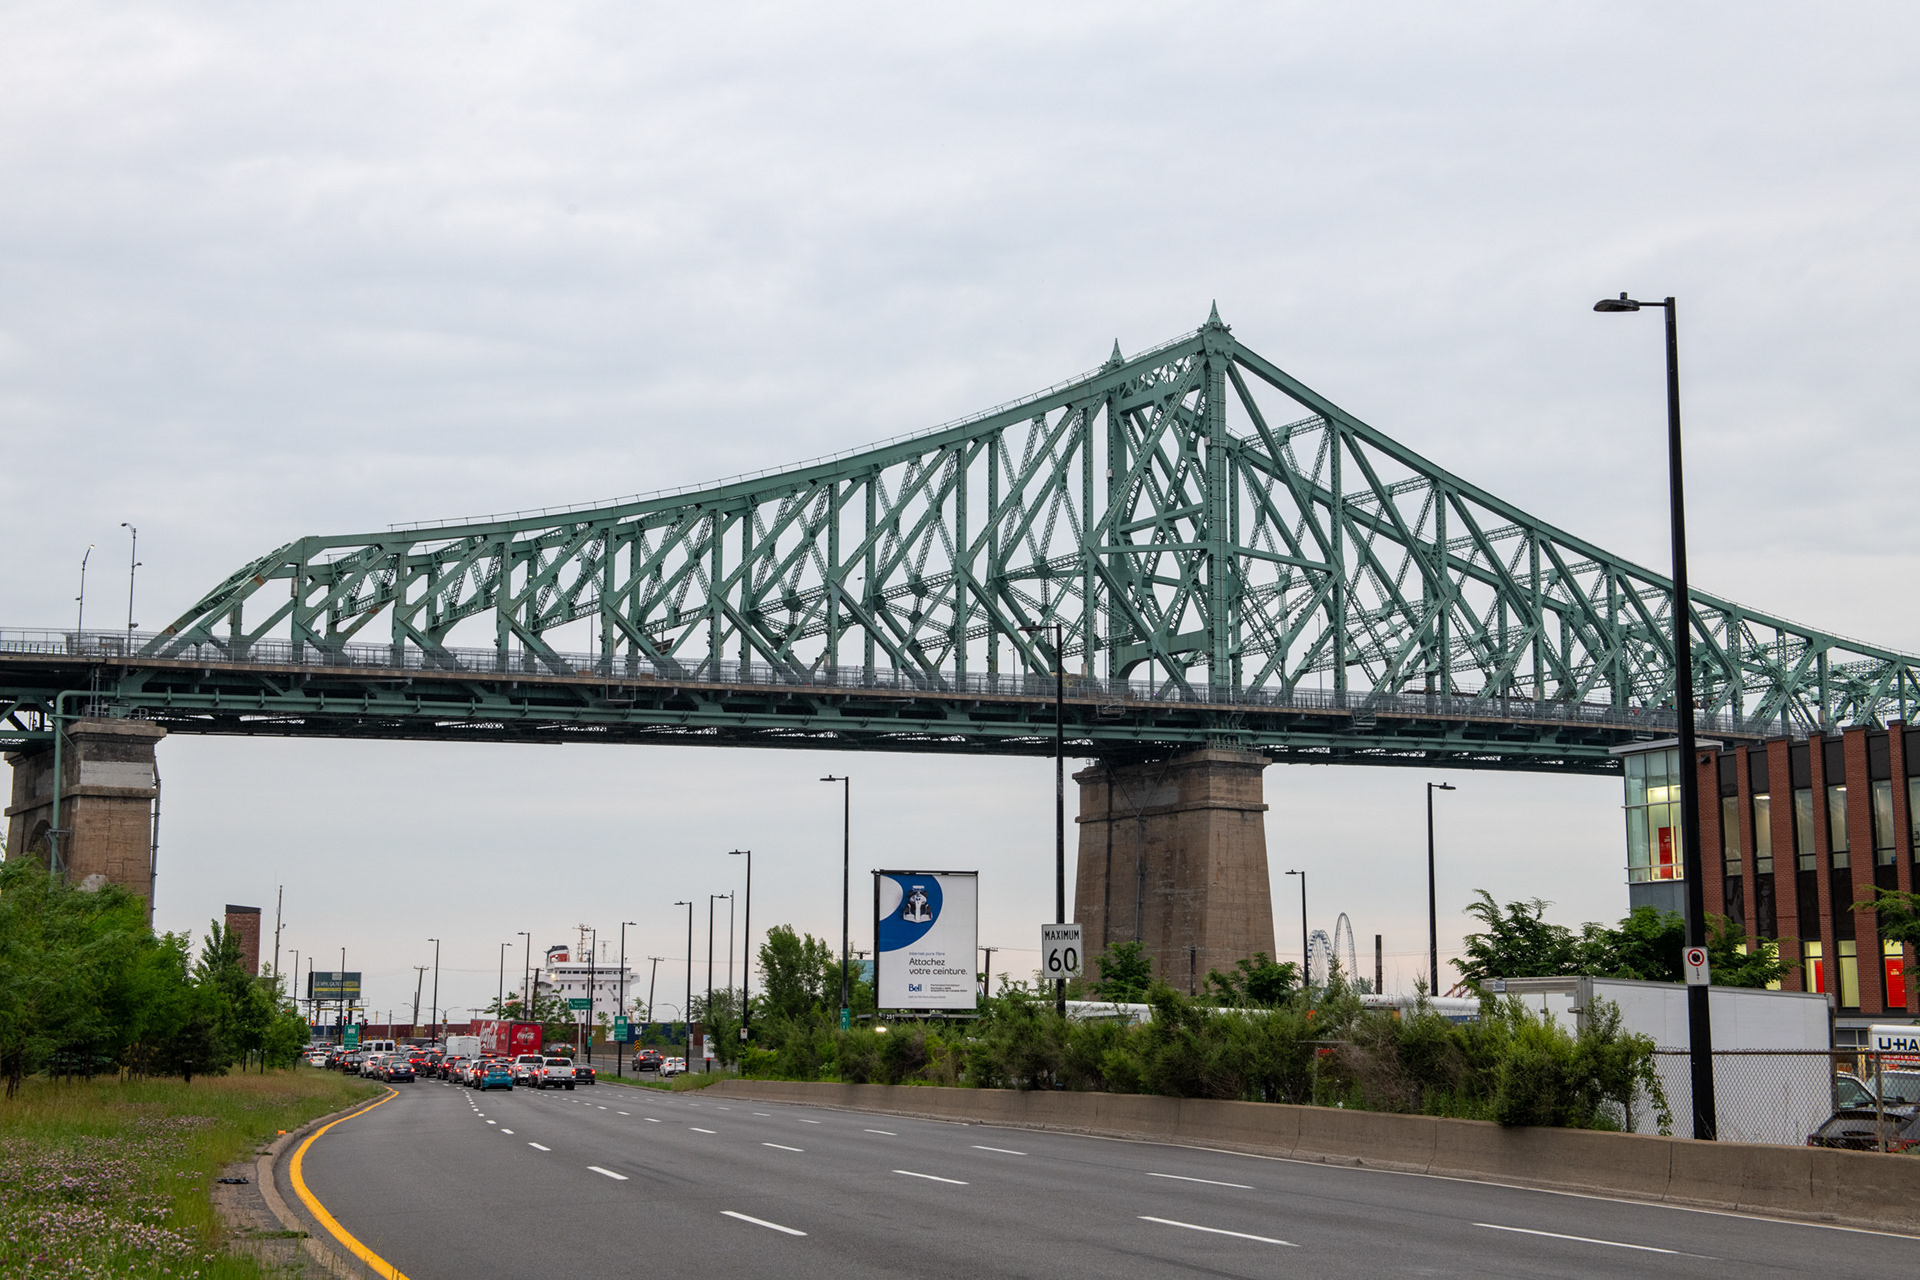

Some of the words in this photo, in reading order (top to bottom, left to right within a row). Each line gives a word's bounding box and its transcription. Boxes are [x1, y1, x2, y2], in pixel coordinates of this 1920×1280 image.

[1045, 930, 1079, 940] MAXIMUM
[909, 957, 945, 966] Attachez
[1048, 947, 1077, 972] 60
[932, 967, 968, 975] ceinture.
[908, 983, 922, 992] Bell
